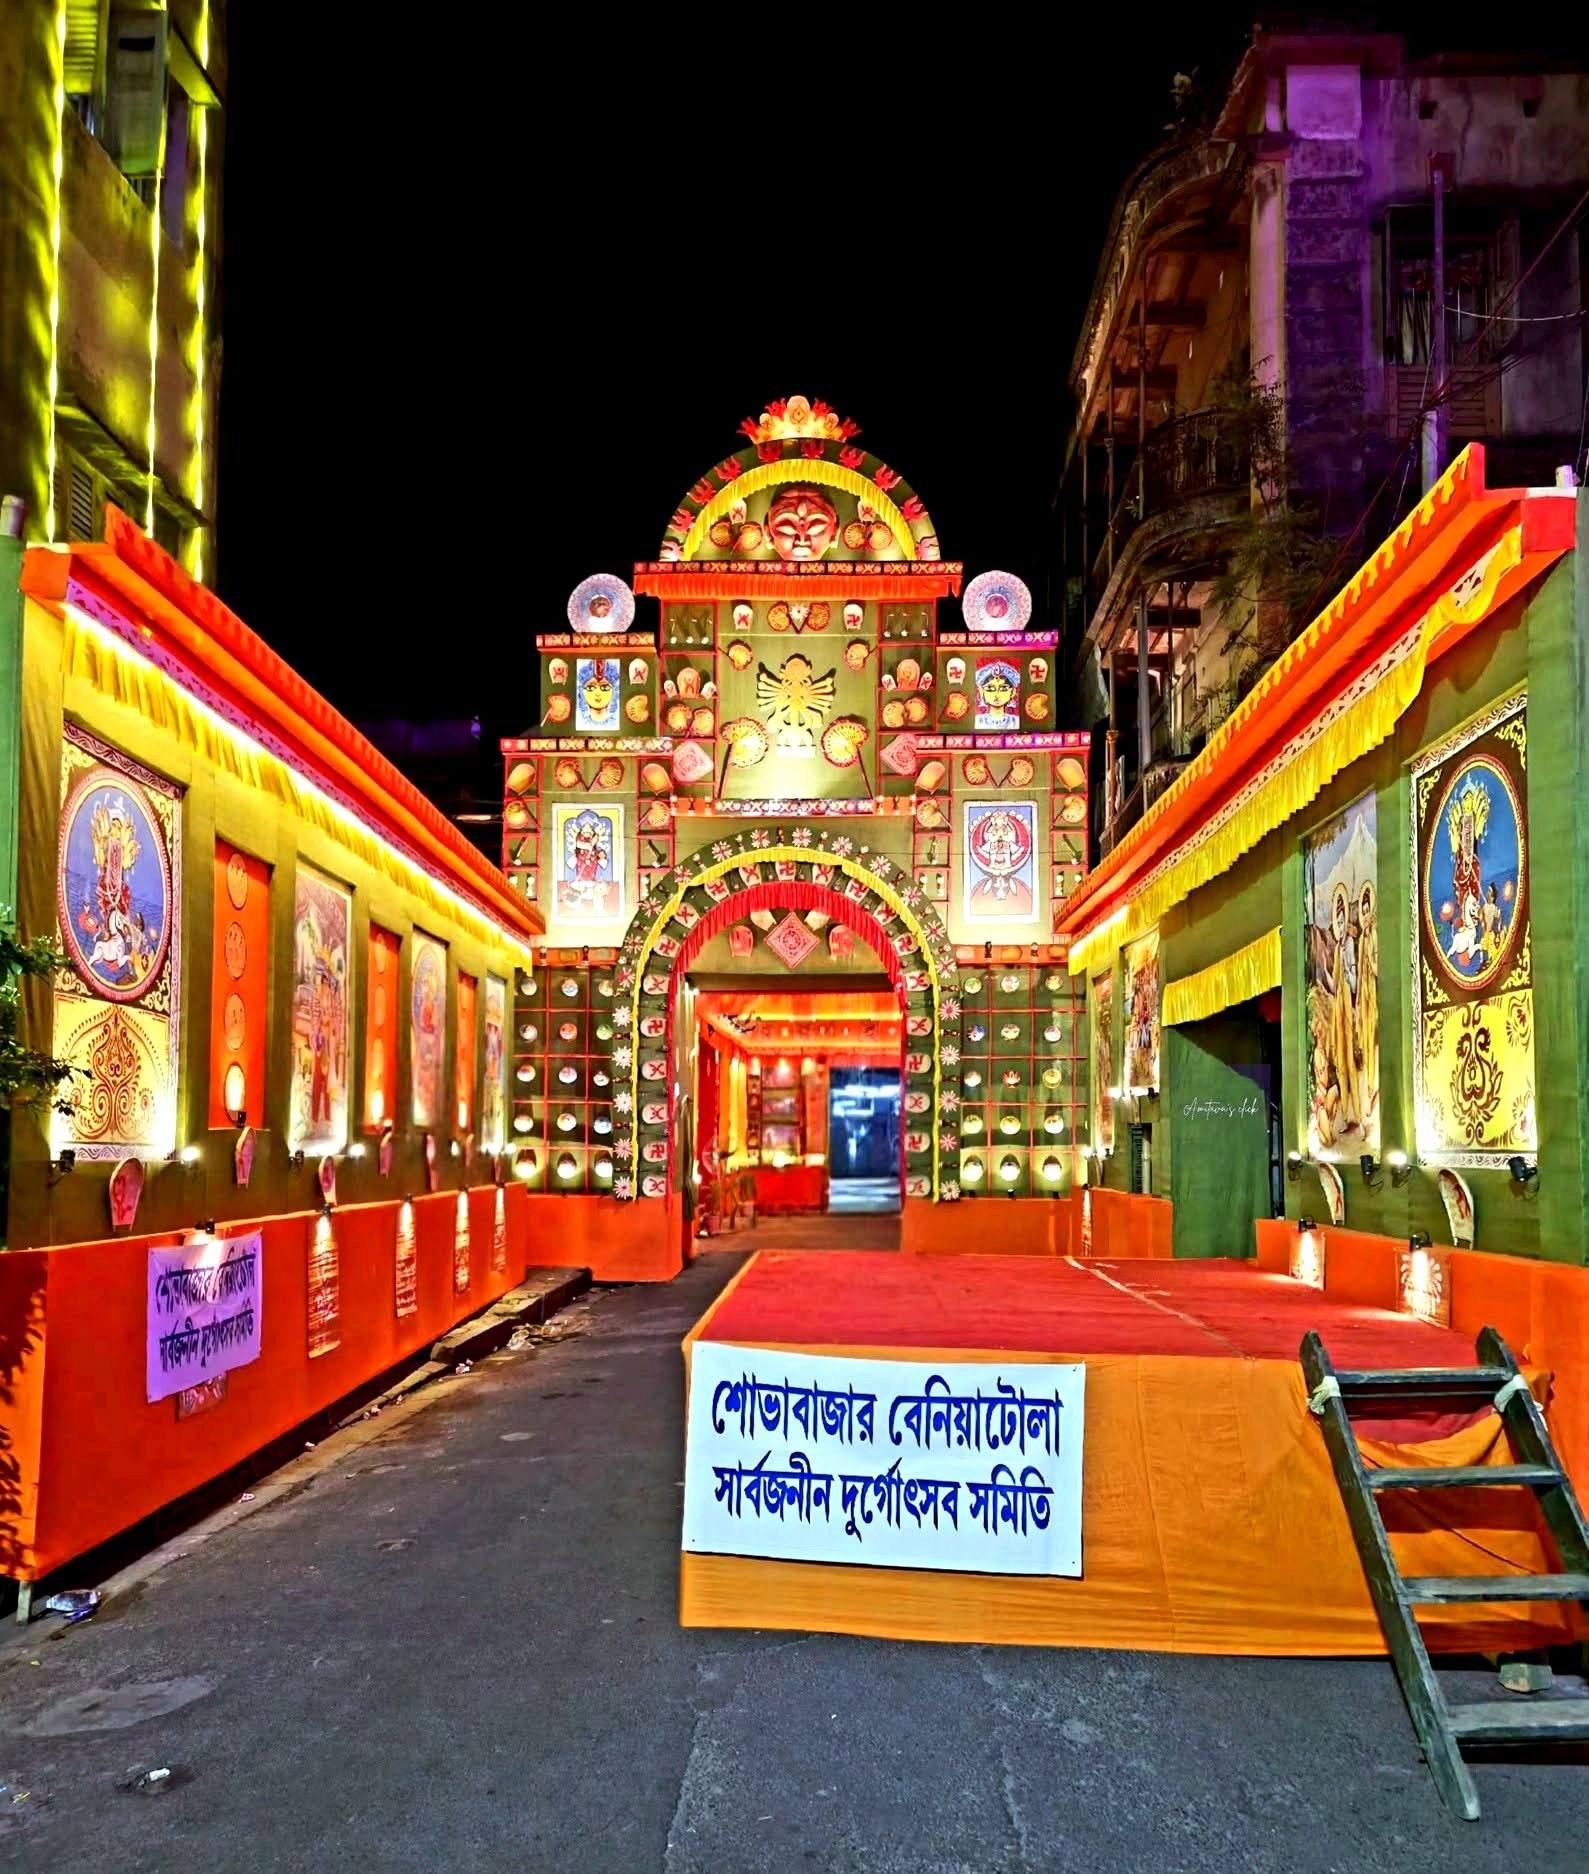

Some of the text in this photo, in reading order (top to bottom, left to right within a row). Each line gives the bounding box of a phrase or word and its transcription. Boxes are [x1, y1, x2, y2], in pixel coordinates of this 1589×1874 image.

[712, 1372, 1064, 1456] শোভাবাজার বেনিয়াটোলা
[712, 1449, 1054, 1543] সার্বজনীন দুর্গোৎসব সমিতি
